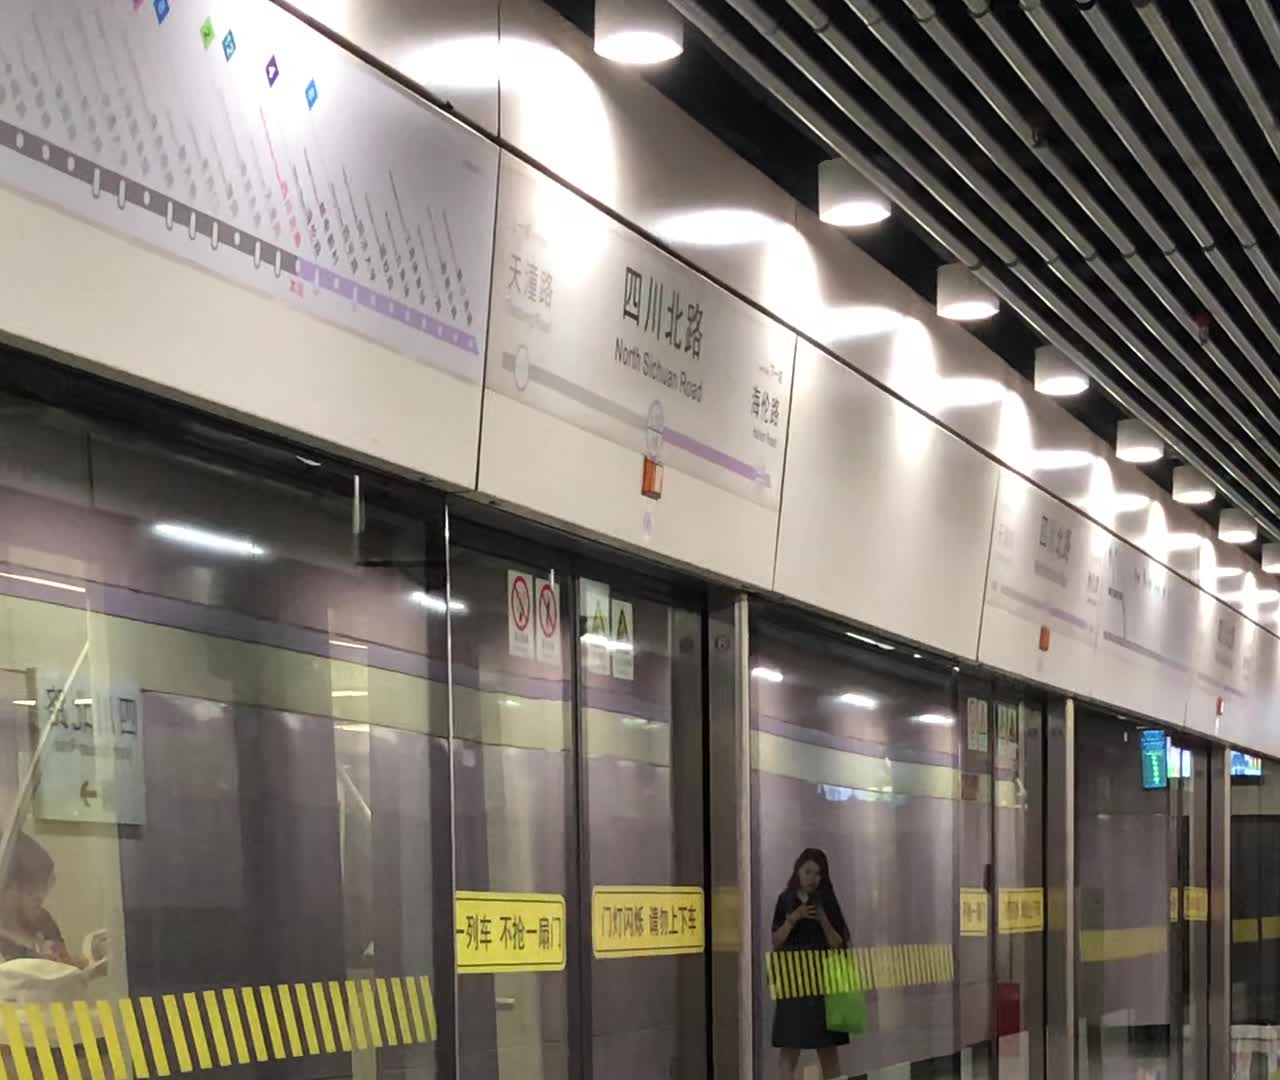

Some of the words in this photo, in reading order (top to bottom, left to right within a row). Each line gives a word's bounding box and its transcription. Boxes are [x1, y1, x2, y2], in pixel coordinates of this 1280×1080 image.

[622, 265, 704, 361] 四川北路
[614, 337, 642, 374] North
[679, 370, 704, 403] Road
[499, 915, 561, 951] 不抢一扇门
